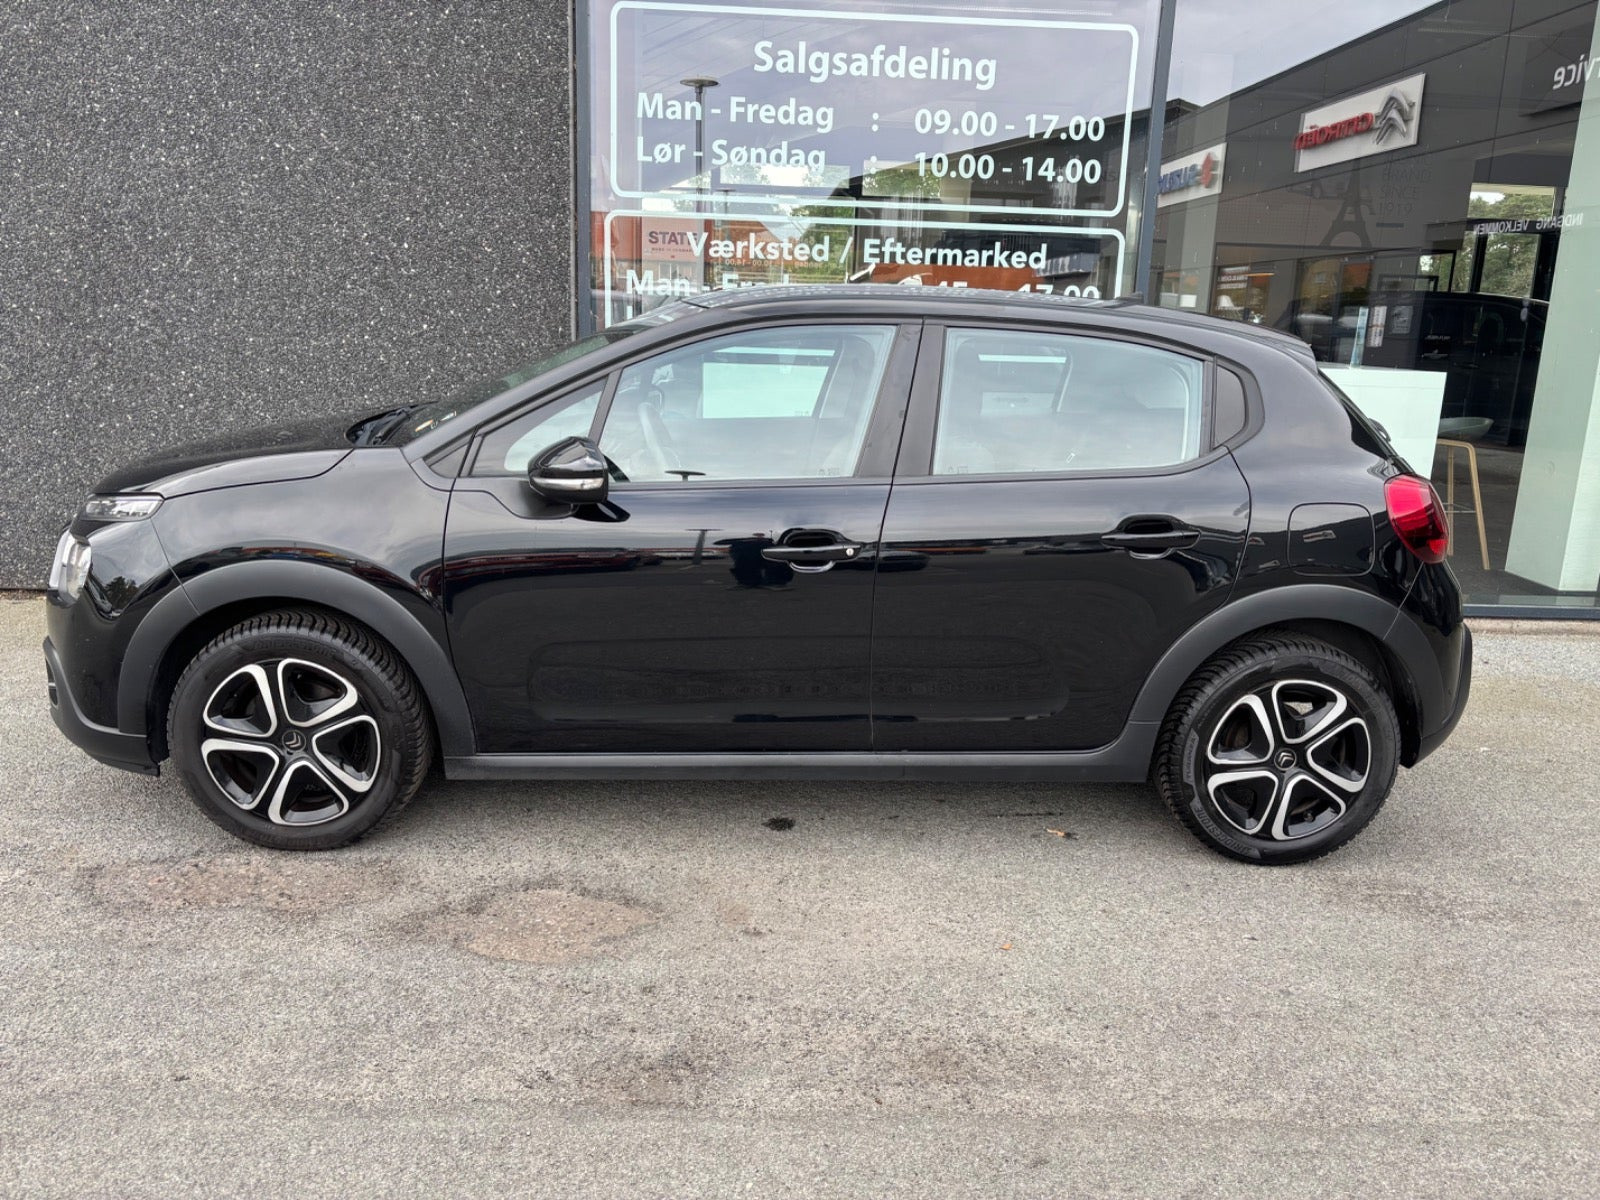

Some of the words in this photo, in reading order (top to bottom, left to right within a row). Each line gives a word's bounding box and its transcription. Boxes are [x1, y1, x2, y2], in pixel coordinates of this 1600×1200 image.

[753, 40, 998, 91] Salgsafdeling
[636, 92, 702, 121] Man
[729, 96, 835, 133] Fredag
[872, 112, 880, 132] :
[914, 108, 998, 137] 09.00
[1024, 114, 1105, 142] 17.00
[636, 136, 686, 164] Lør
[711, 139, 827, 173] Søndag
[914, 152, 996, 180] 10.00
[1021, 156, 1102, 185] 14.00
[686, 231, 829, 263] Værksted
[839, 236, 853, 264] /
[863, 238, 1048, 270] Eftermarked
[626, 269, 690, 298] Man
